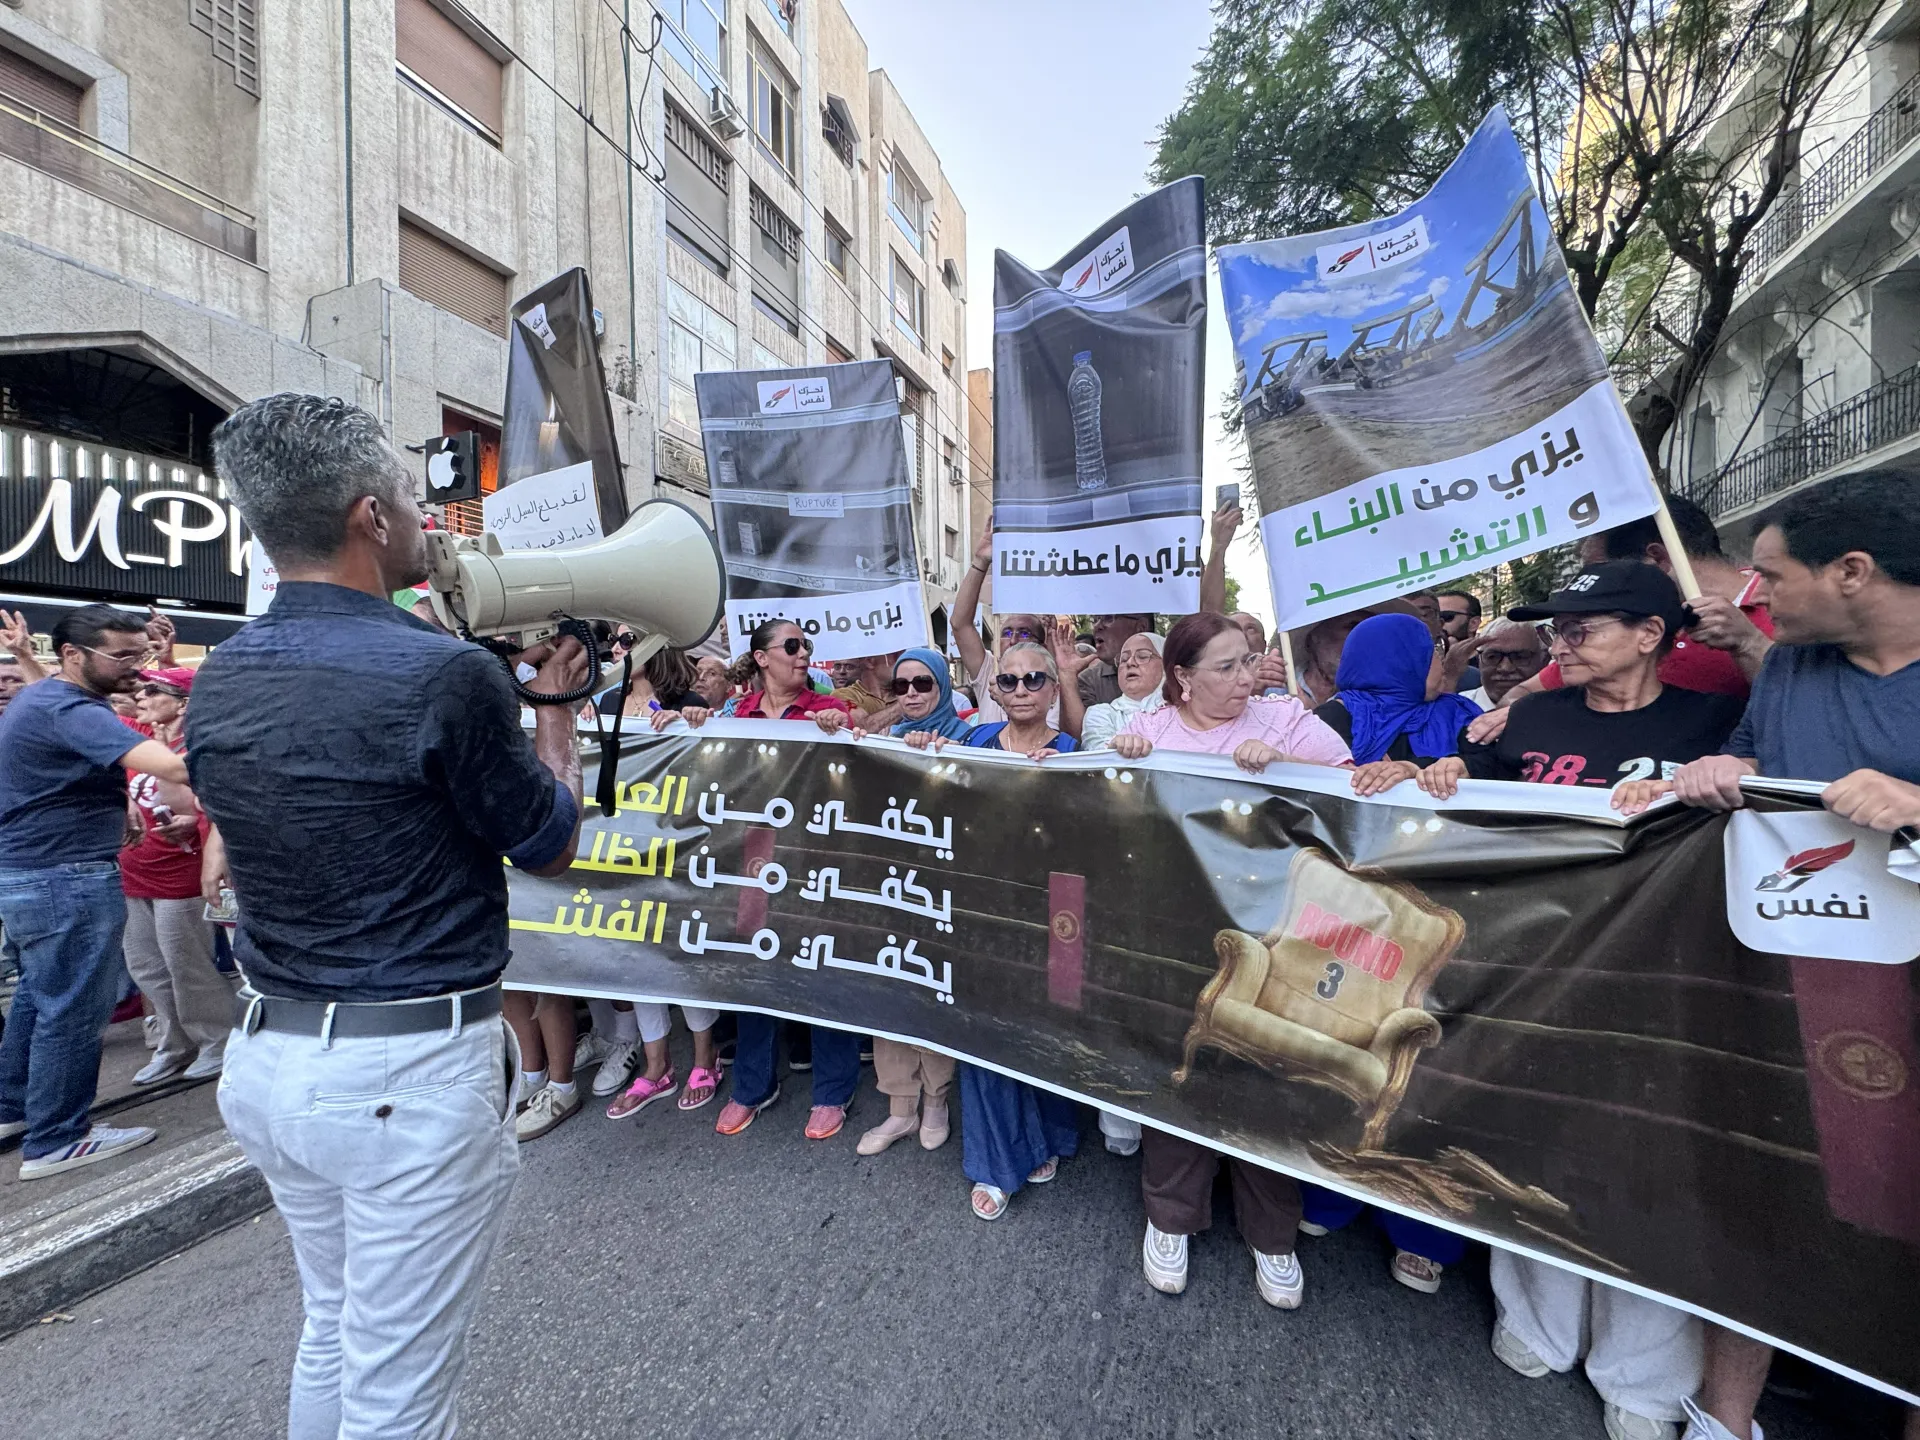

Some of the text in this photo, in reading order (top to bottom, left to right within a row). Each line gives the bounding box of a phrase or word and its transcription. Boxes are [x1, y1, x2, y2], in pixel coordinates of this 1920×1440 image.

[1380, 239, 1419, 262] نفس
[1103, 256, 1127, 281] نفس
[800, 395, 825, 406] نفس
[561, 482, 586, 506] لقد
[794, 497, 839, 508] RUPTURE
[1294, 427, 1584, 548] يزي من البناء
[512, 500, 538, 524] السيل
[538, 499, 559, 522] بلغ
[1000, 536, 1200, 583] يزي ما عطشتنا
[1305, 491, 1601, 606] و التشييد
[825, 610, 851, 633] ما
[856, 602, 903, 636] يزي
[584, 775, 954, 861] يكفي من العب
[688, 845, 788, 894] من
[799, 865, 954, 933] يكفي
[1756, 893, 1870, 921] نفس
[507, 887, 955, 1005] يكفي من الفش
[1295, 901, 1404, 982] ROUND
[1316, 961, 1345, 1001] 3
